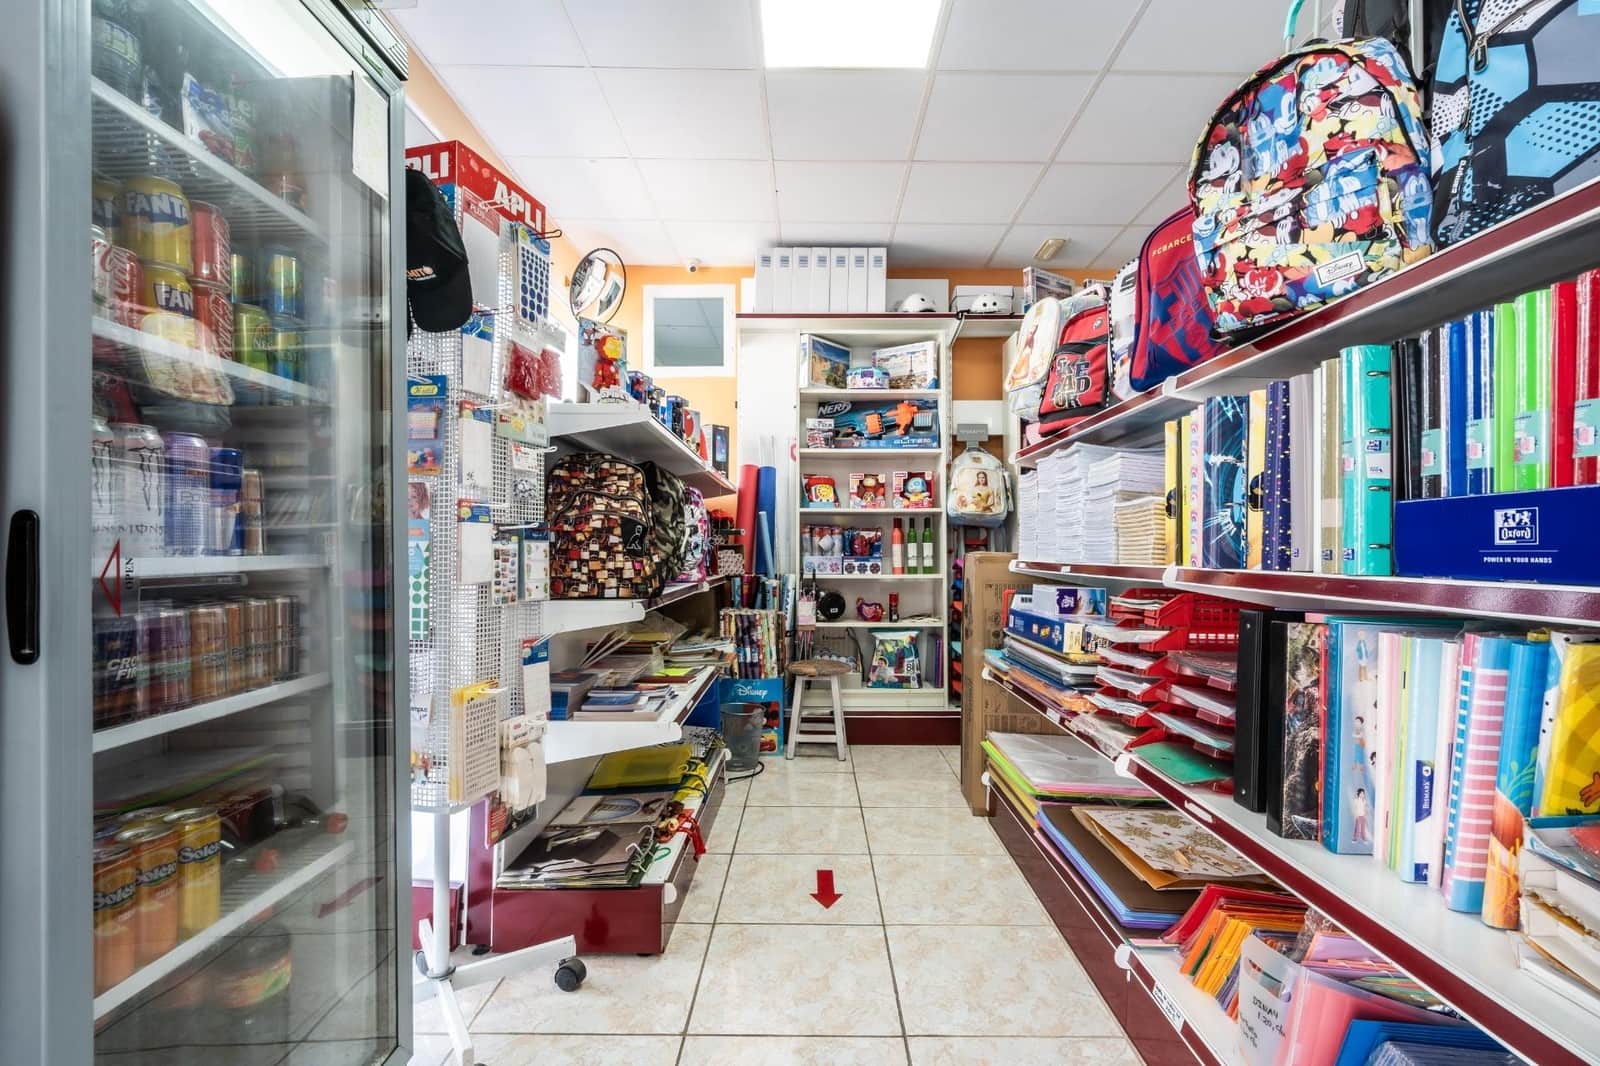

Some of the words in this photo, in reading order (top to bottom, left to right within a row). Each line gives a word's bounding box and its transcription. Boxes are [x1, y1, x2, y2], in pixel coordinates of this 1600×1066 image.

[405, 152, 450, 179] PLI
[494, 180, 543, 232] APLI
[1152, 233, 1193, 257] FCBARCE
[154, 282, 193, 316] FAN
[817, 402, 848, 417] NERF
[1501, 527, 1532, 540] Oxford
[1483, 556, 1503, 564] POWER
[1504, 556, 1512, 564] IN
[1513, 556, 1529, 564] YOUR
[125, 557, 134, 590] OPEN
[734, 683, 769, 699] Disney
